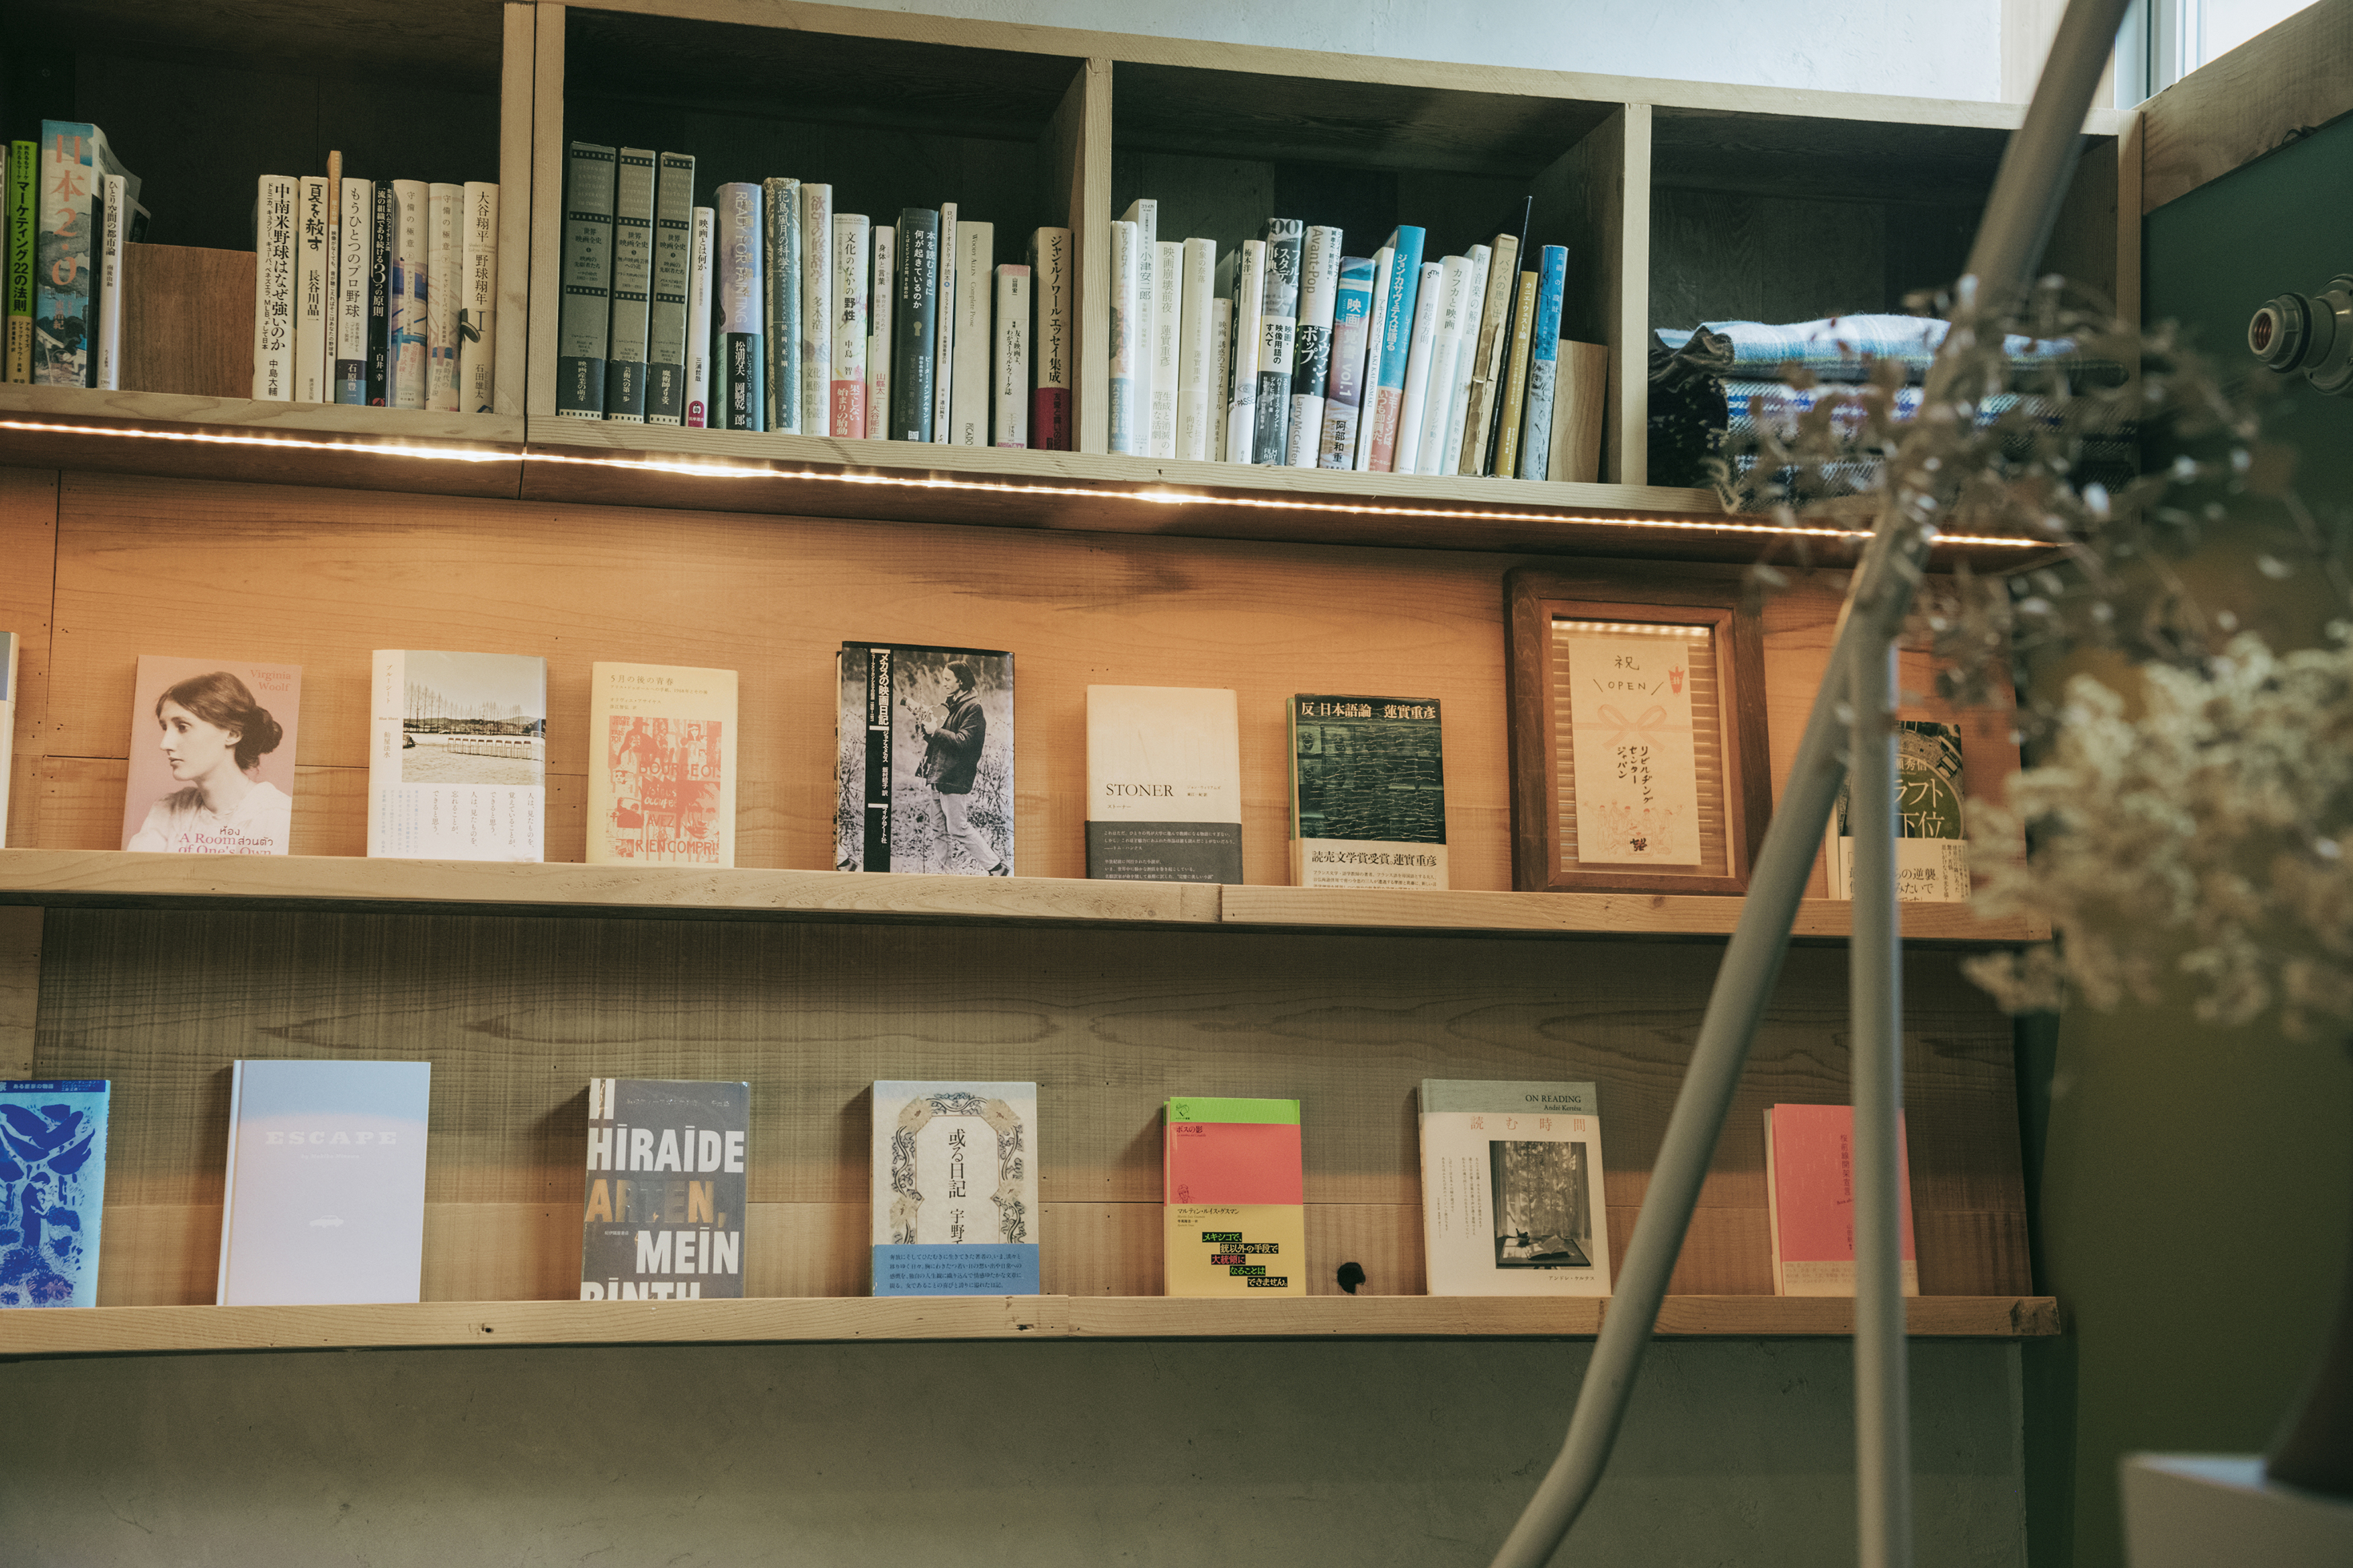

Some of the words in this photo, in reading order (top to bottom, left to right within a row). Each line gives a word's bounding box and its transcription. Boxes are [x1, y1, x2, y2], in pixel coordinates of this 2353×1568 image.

[106, 181, 118, 256] ひとり空間の都市論
[306, 183, 324, 251] 夏を赦す
[406, 192, 415, 248] 守備の極意
[442, 195, 451, 251] 守備の極意
[476, 192, 489, 243] 大谷翔平
[778, 190, 790, 270] 花鳥風月の科学
[13, 181, 30, 312] マーケティング22の法則
[346, 188, 361, 318] もうひとつのプロ野球
[373, 188, 386, 317] 一流の組織であり続ける3つの原則
[698, 219, 709, 271] 映画とは何か
[878, 244, 887, 286] 身体と言葉
[926, 231, 936, 296] 本を読むときに
[945, 211, 953, 281] ロバート・オルドリッチ読本
[1121, 229, 1129, 280] エリック・ロメール
[1197, 243, 1207, 284] 表象の奈落
[1243, 249, 1252, 276] 梅本洋一
[1266, 247, 1279, 274] 事典
[1304, 229, 1323, 294] Avant-Pop
[271, 183, 290, 351] 中南米野球はなぜ強いのか
[475, 254, 489, 305] 野球翔年
[844, 232, 856, 321] 文化のなかの野性
[913, 229, 924, 309] 何が起きているのか
[1050, 236, 1062, 316] ジャン・ルノワール
[1140, 251, 1152, 300] 小津安二郎
[1162, 247, 1175, 314] 映画崩壊前夜
[1277, 247, 1291, 310] スタディーズ
[1289, 249, 1301, 288] フィルム
[1427, 270, 1440, 278] smt
[1551, 253, 1564, 313] 芸術の設計
[307, 270, 320, 321] 長谷川晶一
[1386, 254, 1408, 351] ジョン・カサヴェテスは語る
[1445, 269, 1462, 330] カフカと映画
[1466, 252, 1486, 336] 新・音楽の解読
[1492, 259, 1509, 319] バッハの思い出
[1343, 298, 1362, 360] 映画覚書
[1519, 282, 1532, 340] カニエ・ウェスト論
[1049, 319, 1062, 383] エッセイ集成
[1160, 325, 1172, 367] 蓮實重彦
[1265, 323, 1275, 347] すべて
[1273, 324, 1283, 364] 映像用語の
[1300, 326, 1319, 365] ポップ
[268, 360, 278, 396] 中島大輔
[347, 364, 357, 397] 石原豊一
[475, 364, 484, 399] 石田雄太
[577, 361, 587, 401] 映画産業の萌芽
[1005, 330, 1013, 395] わがヌーヴェル・ヴァーグ誌
[1193, 351, 1202, 384] 蓮實重彦
[1215, 341, 1226, 410] 誘惑のエクリチュール
[1339, 364, 1353, 397] vol.1
[623, 366, 631, 402] 芸術への第一歩
[661, 370, 671, 405] 魔術師メリエス
[849, 384, 861, 421] 果てしない
[876, 373, 886, 400] 山縣太一
[923, 356, 931, 425] ピーター・メンデルサンド
[1367, 368, 1378, 407] KAURISMAKI
[836, 388, 848, 436] 始まりの胎動
[870, 406, 880, 434] 大谷能生
[1152, 391, 1162, 440] 苛酷な活劇
[1162, 392, 1172, 450] 生成と消滅の
[1295, 396, 1305, 415] Larry
[1373, 390, 1388, 445] いつも即興だ。
[1383, 391, 1398, 449] エモーションは、
[1186, 416, 1195, 438] 向けて
[1288, 417, 1303, 467] McCaffery
[1332, 421, 1347, 463] 阿部和重
[250, 670, 291, 682] Virginia
[610, 675, 674, 686] 5月の後の青春
[1614, 655, 1640, 671] 祝
[258, 682, 290, 692] Woolf
[878, 653, 890, 726] メカスの映画日記
[1607, 680, 1646, 691] OPEN
[1302, 702, 1372, 718] 反日本語論
[1384, 704, 1436, 720] 蓮實重彦
[383, 731, 391, 759] 飴屋法水
[1617, 745, 1628, 779] ジャパン
[1629, 745, 1638, 784] センター
[639, 763, 721, 778] BOURGEOIS
[1106, 783, 1174, 797] STONER
[1639, 745, 1654, 804] リビルヂング
[220, 826, 240, 835] ห้อง
[431, 790, 440, 835] できると思う。
[450, 790, 459, 835] 忘れることが、
[470, 791, 478, 847] 人は、見たものを、
[489, 792, 497, 836] できると思う。
[508, 792, 516, 848] 覚えていることが、
[647, 814, 675, 827] AVEZ
[180, 833, 190, 843] A
[195, 833, 235, 845] Room
[238, 836, 273, 846] ส่วนตัว
[635, 839, 666, 854] RIEN
[667, 841, 720, 856] COMPRIS
[1312, 851, 1437, 867] 読売文学賞受賞。蓮實重彦
[1525, 1094, 1539, 1102] ON
[1541, 1095, 1581, 1104] READING
[266, 1130, 397, 1145] ESCAPE
[1176, 1125, 1203, 1134] ボスの影
[1470, 1116, 1586, 1132] 読む時間
[949, 1128, 967, 1199] 或る日記
[950, 1208, 965, 1244] 宇野
[1177, 1207, 1240, 1215] マルティン・ルイス・グスマン
[636, 1227, 740, 1274] MEIN
[1202, 1233, 1242, 1242] メキシコで、
[1220, 1243, 1278, 1253] 銃以外の手段で
[1211, 1255, 1245, 1264] 大統領に
[1230, 1266, 1265, 1275] なることは
[1248, 1278, 1287, 1287] できません。
